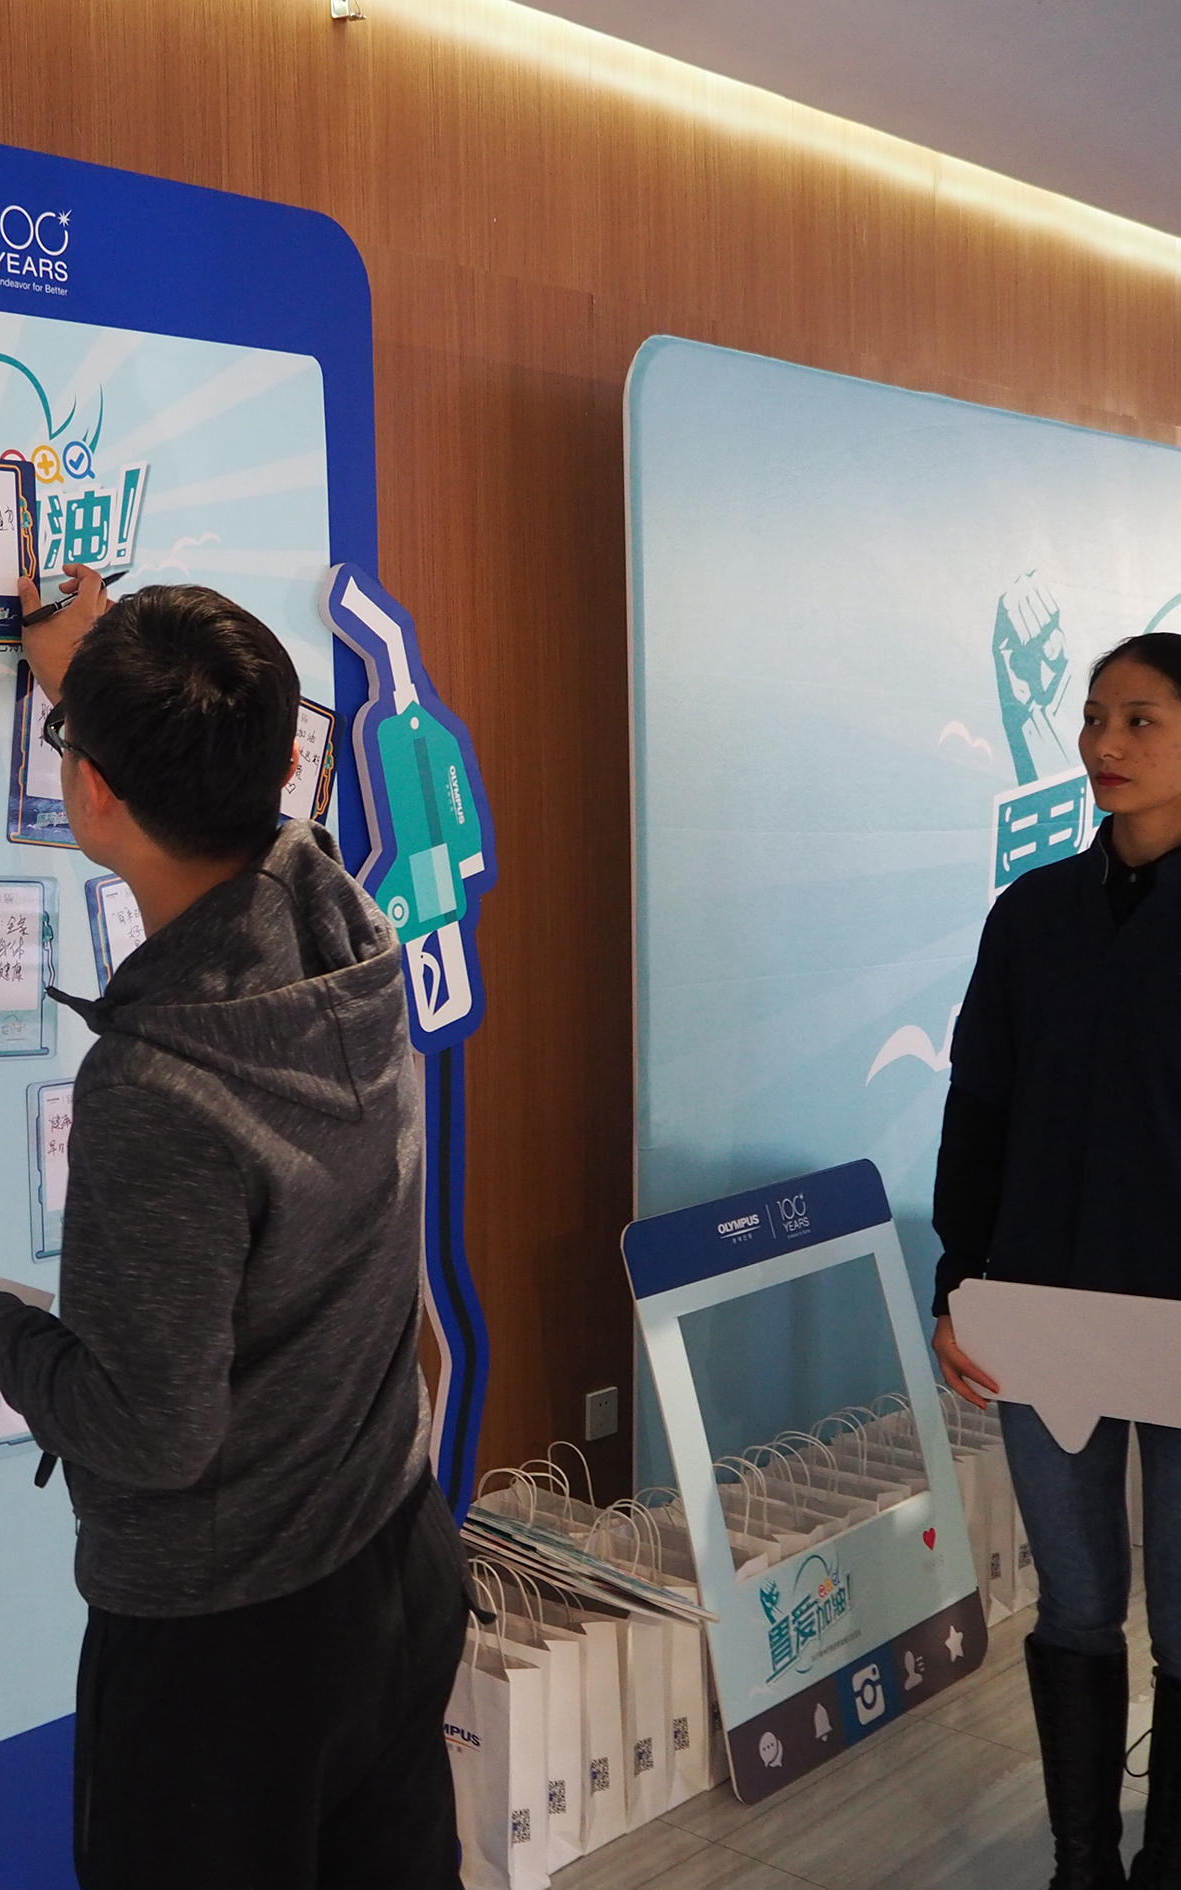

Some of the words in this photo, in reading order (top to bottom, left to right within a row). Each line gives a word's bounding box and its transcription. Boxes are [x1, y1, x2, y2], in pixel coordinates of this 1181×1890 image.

[32, 282, 43, 292] for
[44, 284, 68, 296] Better
[448, 764, 466, 825] OLYMPUS
[776, 1194, 808, 1221] 100
[717, 1213, 760, 1234] OLYMPUS
[782, 1216, 811, 1233] YEARS
